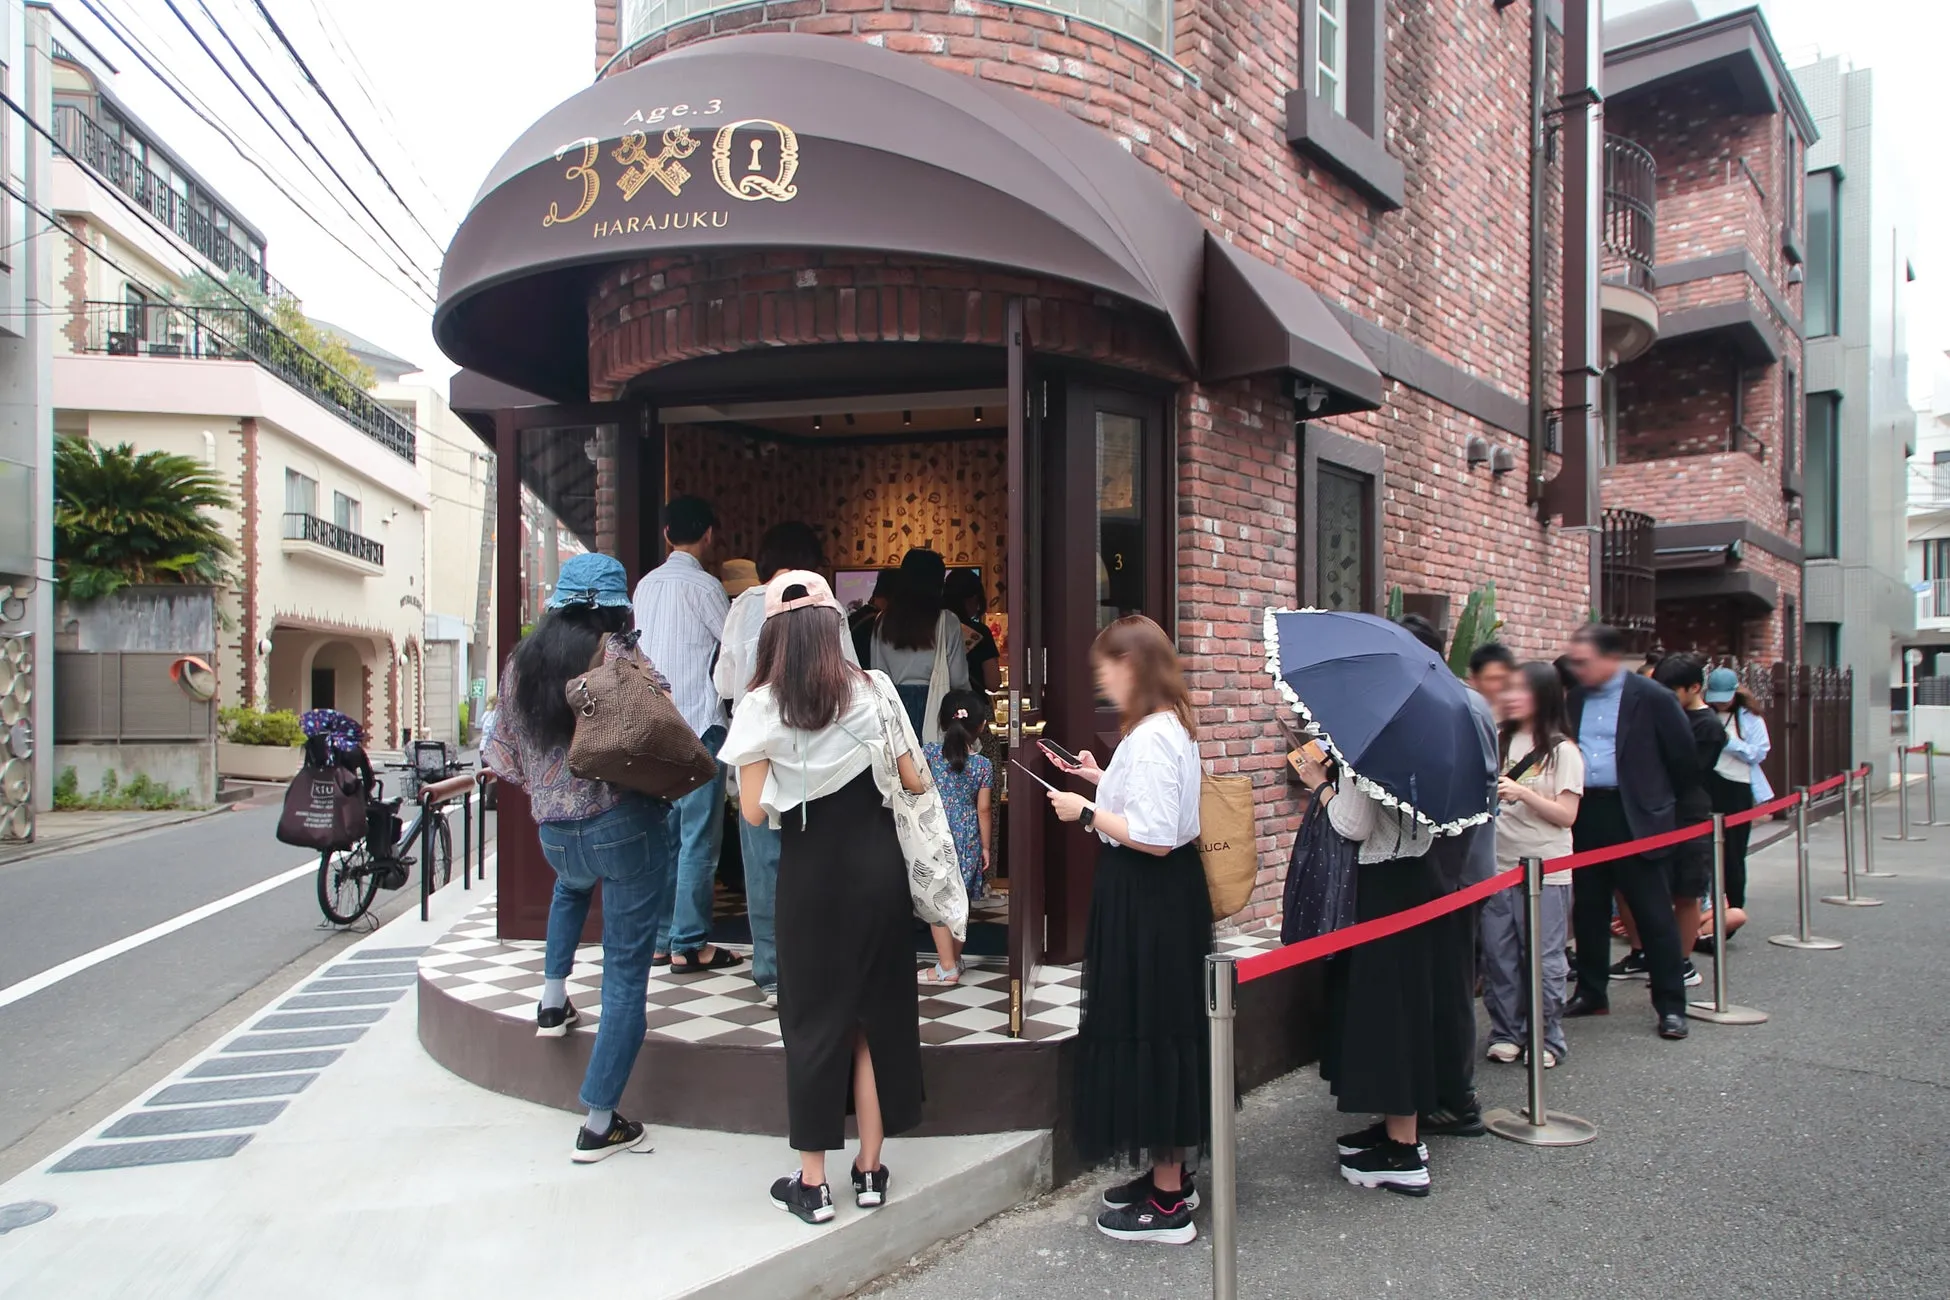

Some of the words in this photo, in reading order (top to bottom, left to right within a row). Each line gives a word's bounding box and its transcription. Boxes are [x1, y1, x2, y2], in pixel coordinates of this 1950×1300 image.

[623, 98, 722, 126] Age.3
[593, 210, 730, 239] HARAJUKU
[1114, 553, 1123, 570] 3
